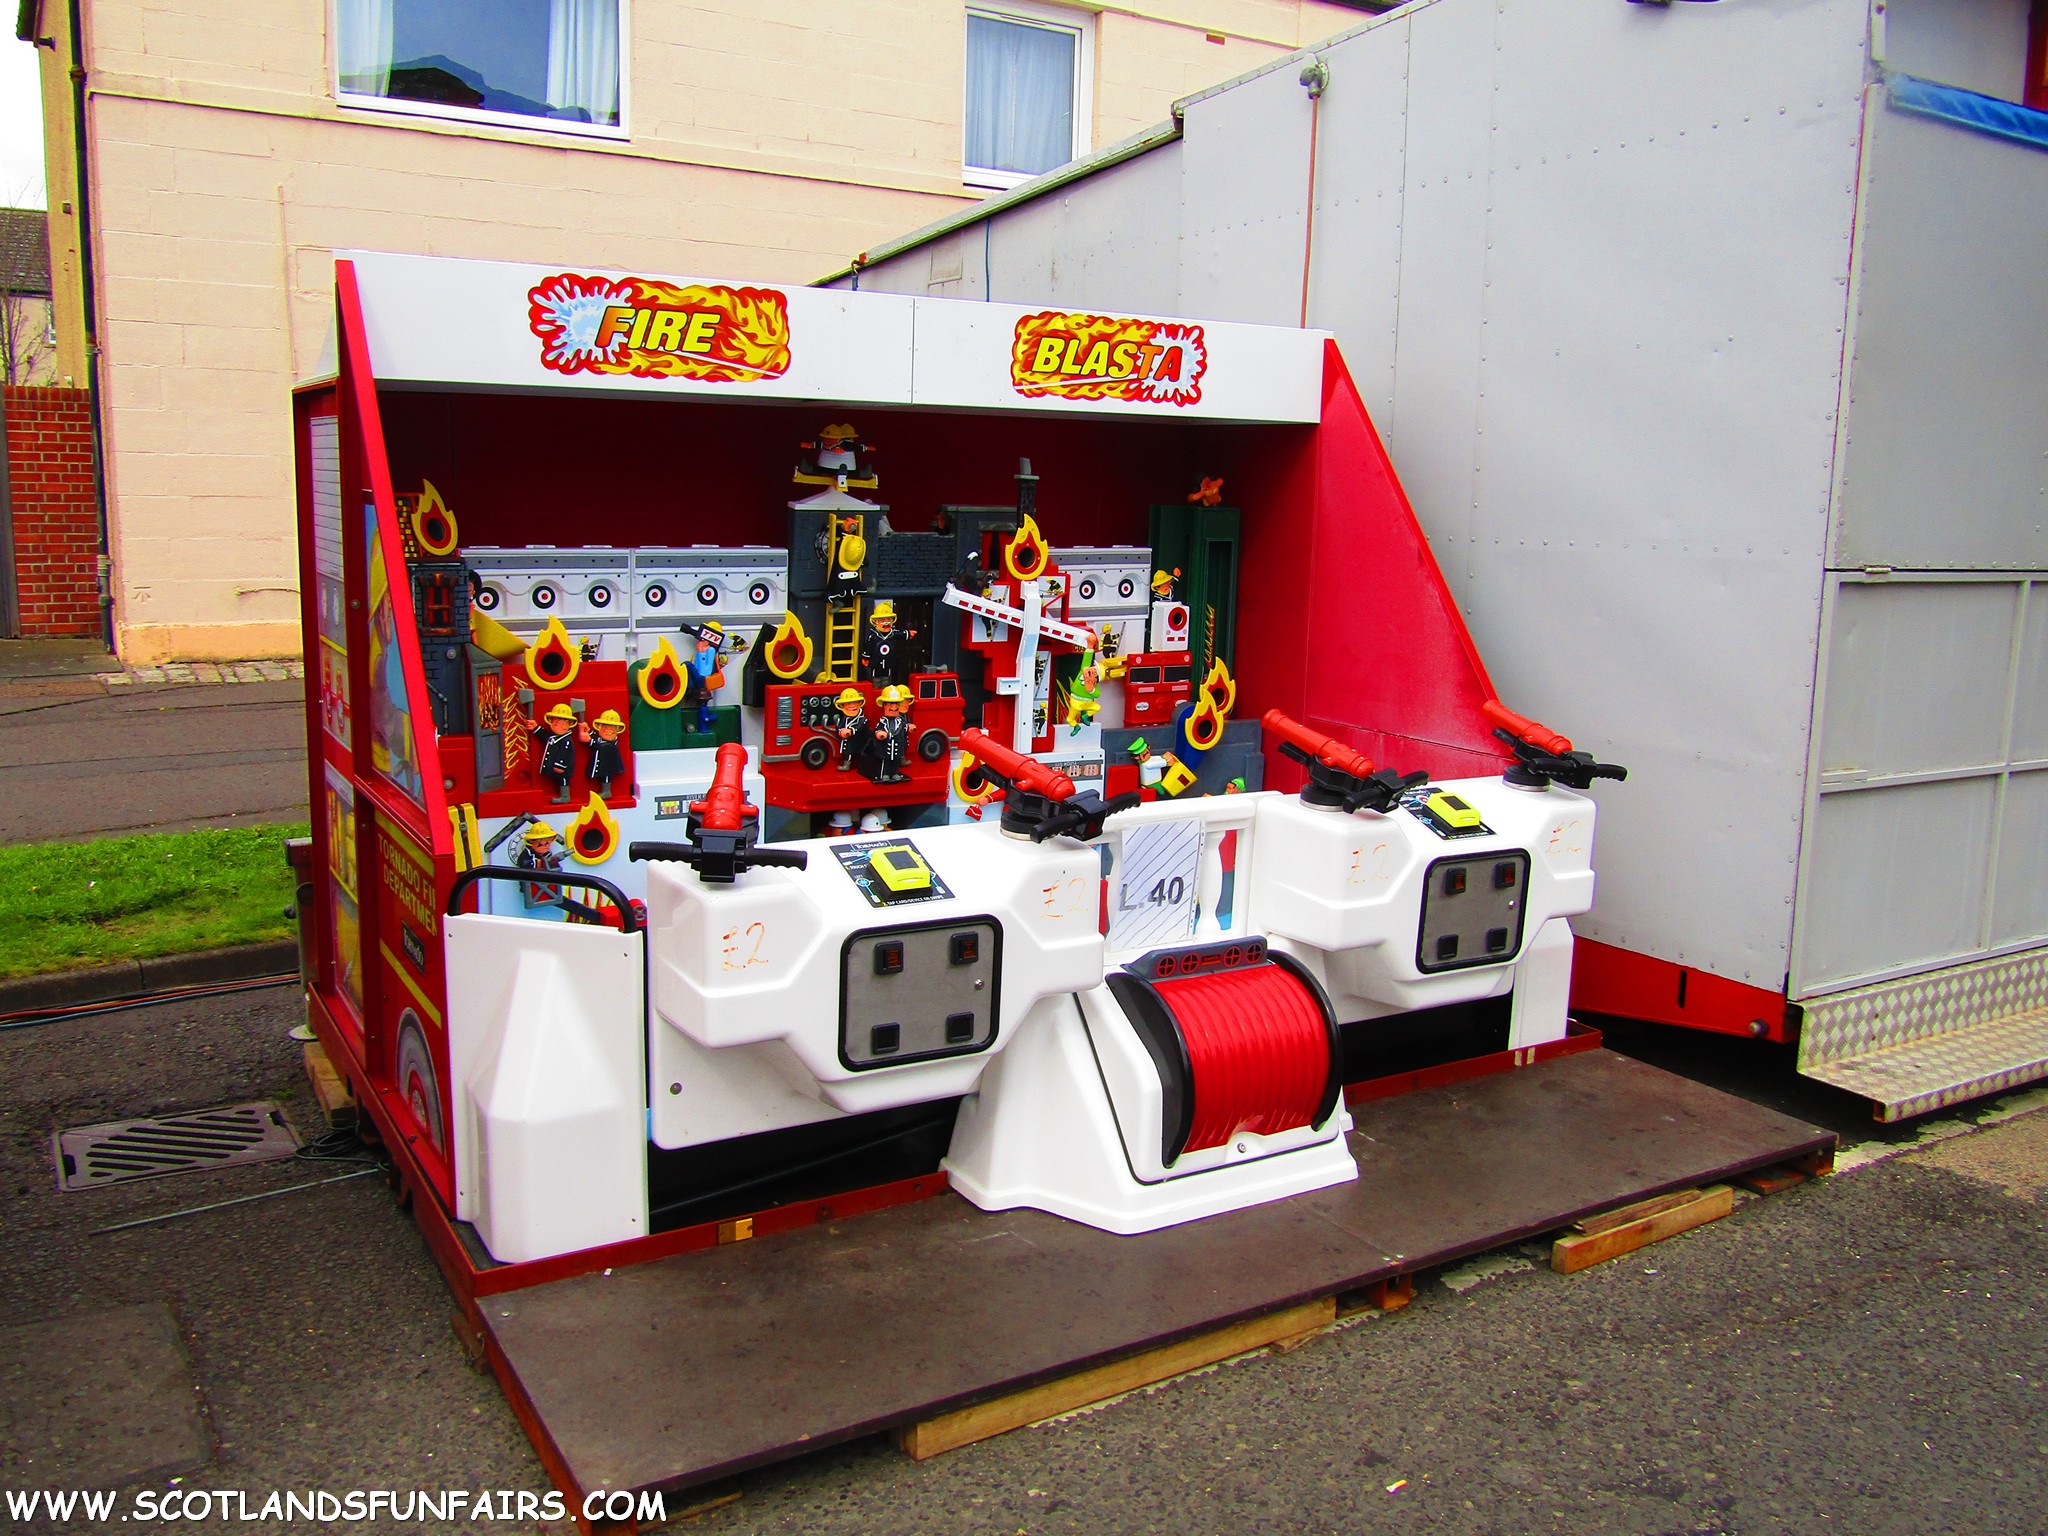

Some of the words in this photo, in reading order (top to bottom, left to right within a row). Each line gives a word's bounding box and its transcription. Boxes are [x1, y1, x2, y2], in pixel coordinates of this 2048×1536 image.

[595, 306, 721, 353] FIRE
[1032, 337, 1183, 382] BLASTA
[702, 630, 721, 643] TTV
[378, 832, 420, 893] TORNADO
[1041, 877, 1088, 918] £2
[722, 922, 769, 971] £2
